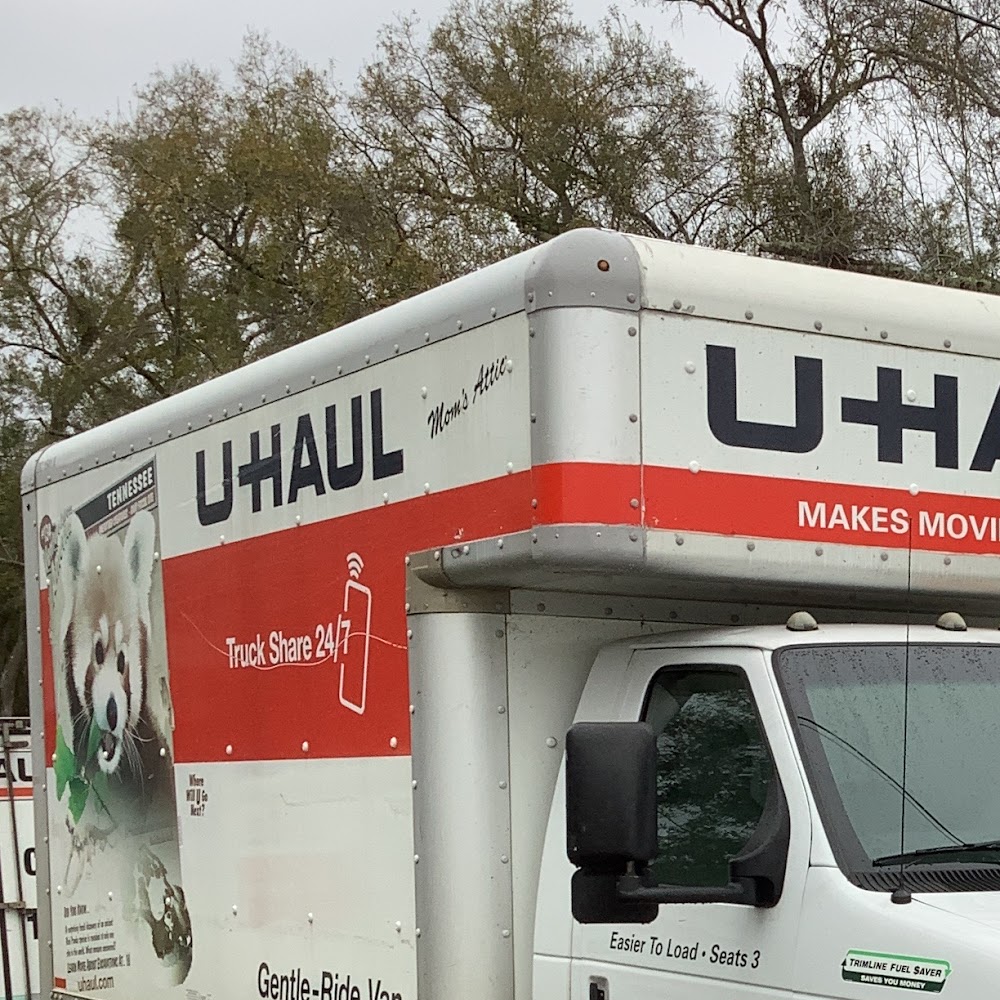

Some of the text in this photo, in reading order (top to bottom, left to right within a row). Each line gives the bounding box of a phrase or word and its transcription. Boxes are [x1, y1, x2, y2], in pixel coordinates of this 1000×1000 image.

[428, 355, 508, 439] Mom's Attic
[196, 388, 404, 526] U-HAUL
[106, 466, 154, 510] TENNESSEE
[798, 501, 911, 534] MAKES
[226, 614, 351, 668] Truck Share 24/7
[610, 932, 761, 969] Easier To Load Seats 3
[849, 959, 888, 970] TRIMLINE
[890, 964, 911, 973] FUEL
[78, 975, 114, 992] uhaul.com
[860, 975, 926, 989] SAVES YOU MONEY
